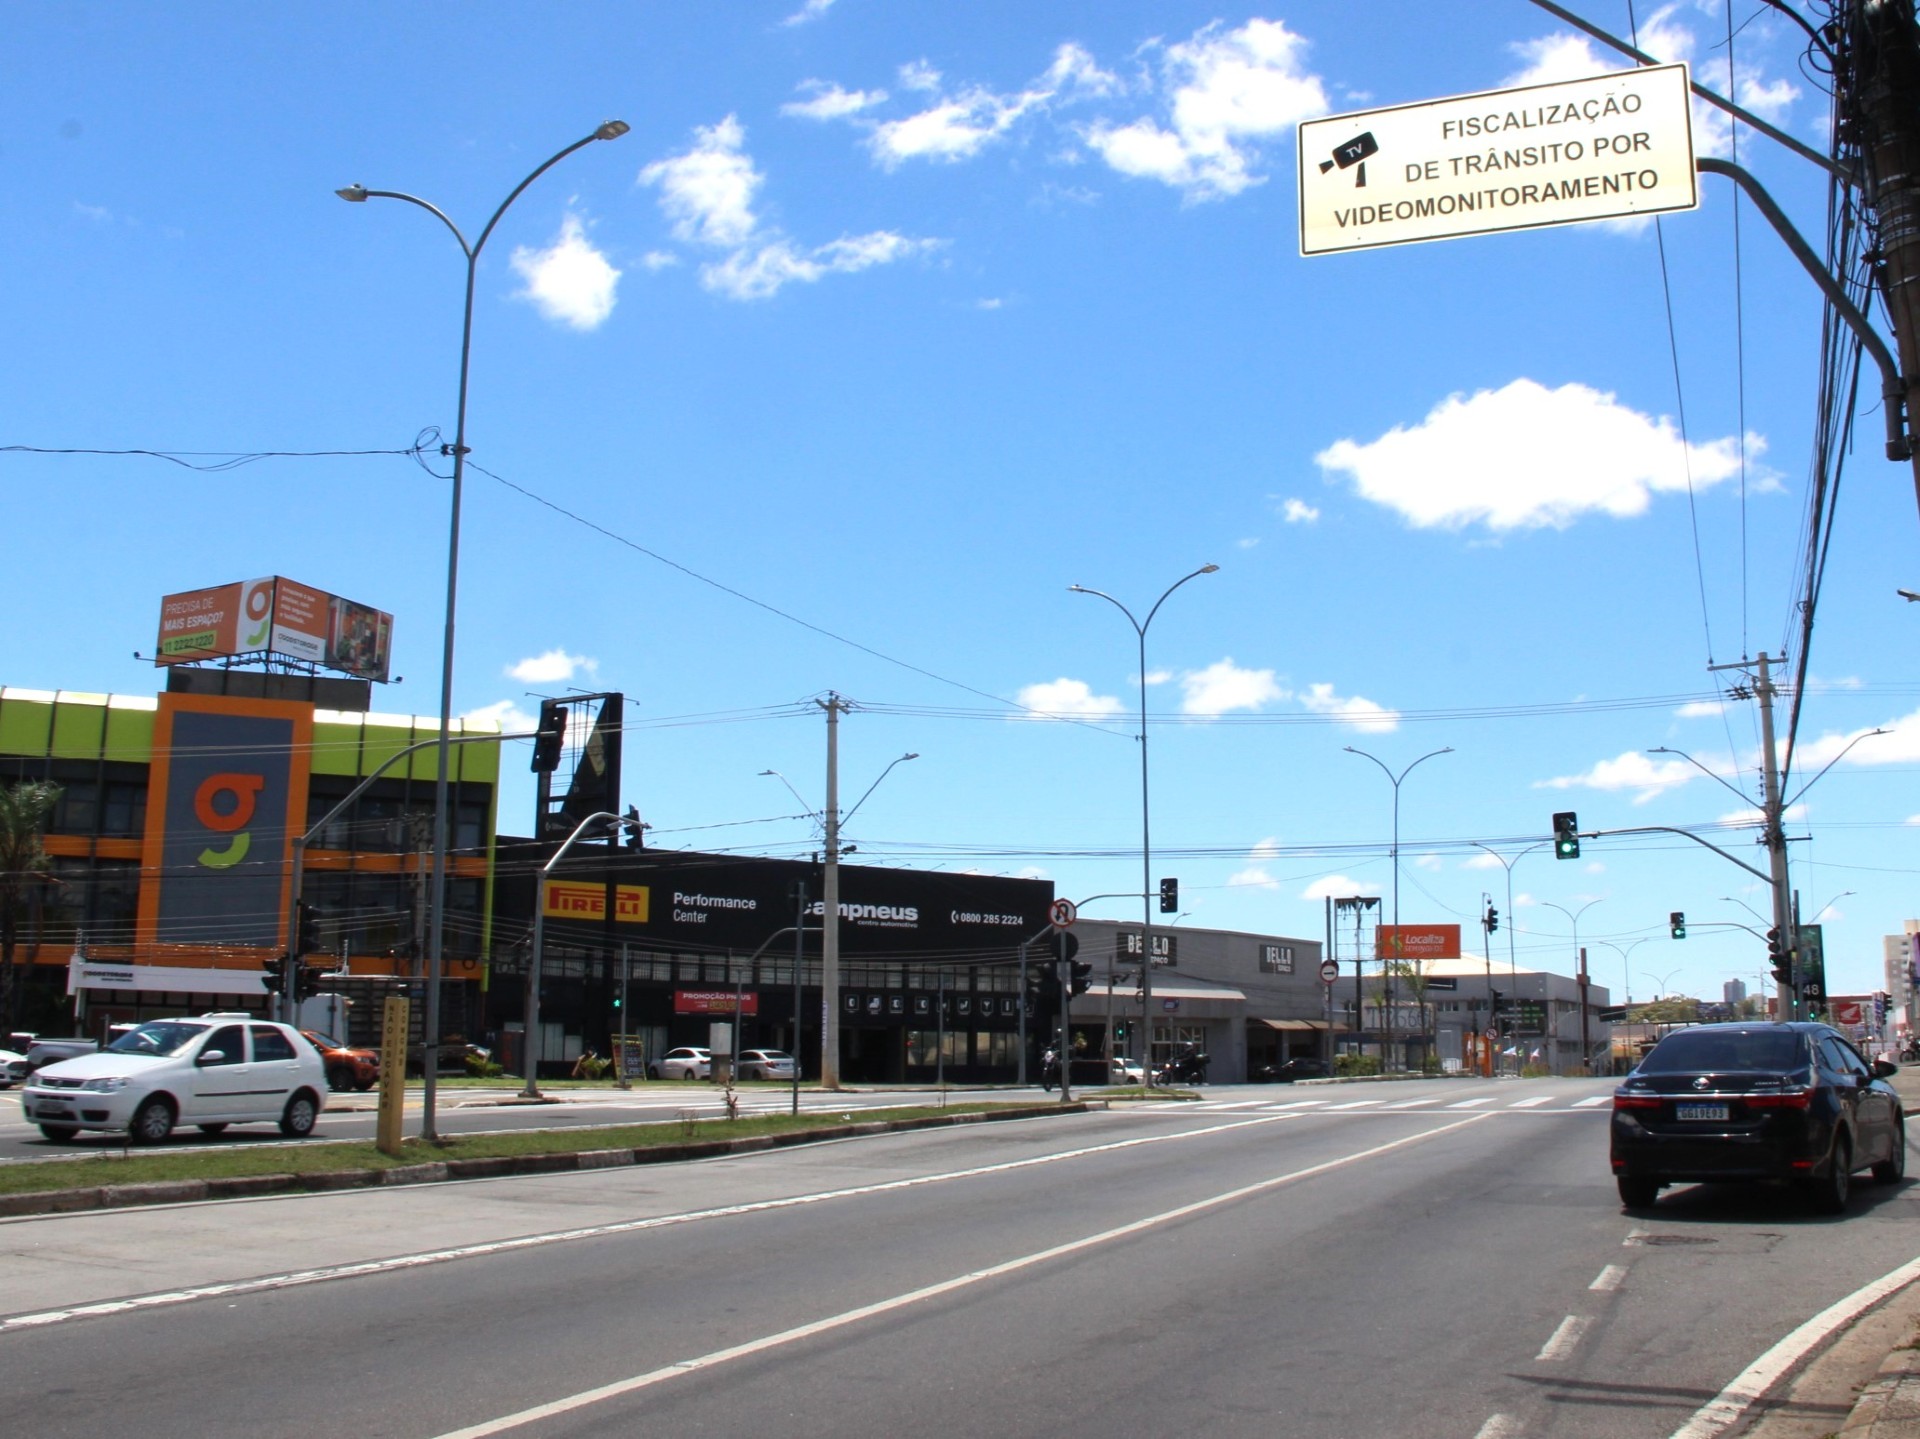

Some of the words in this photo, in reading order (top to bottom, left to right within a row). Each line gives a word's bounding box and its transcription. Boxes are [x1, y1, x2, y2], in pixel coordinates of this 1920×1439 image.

[1442, 92, 1642, 140] FISCALIZAÇÃO
[1346, 143, 1363, 158] TV
[1406, 161, 1440, 183] DE
[1448, 141, 1584, 176] TRÂNSITO
[1593, 132, 1652, 157] POR
[1334, 169, 1658, 228] VIDEOMONITORAMENTO
[165, 600, 200, 615] PRECISA
[202, 597, 214, 610] DE
[164, 618, 185, 631] MAIS
[187, 611, 224, 627] ESPAÇO?
[549, 886, 640, 915] PIRELI
[673, 892, 757, 910] Performance
[673, 909, 708, 923] Center
[960, 912, 981, 923] 0800
[983, 913, 1000, 924] 285
[1001, 915, 1023, 925] 2224
[1128, 934, 1169, 955] BELO
[1405, 934, 1445, 944] Localiza
[1266, 946, 1291, 965] BELLO
[683, 992, 725, 1001] PROMOÇÃO
